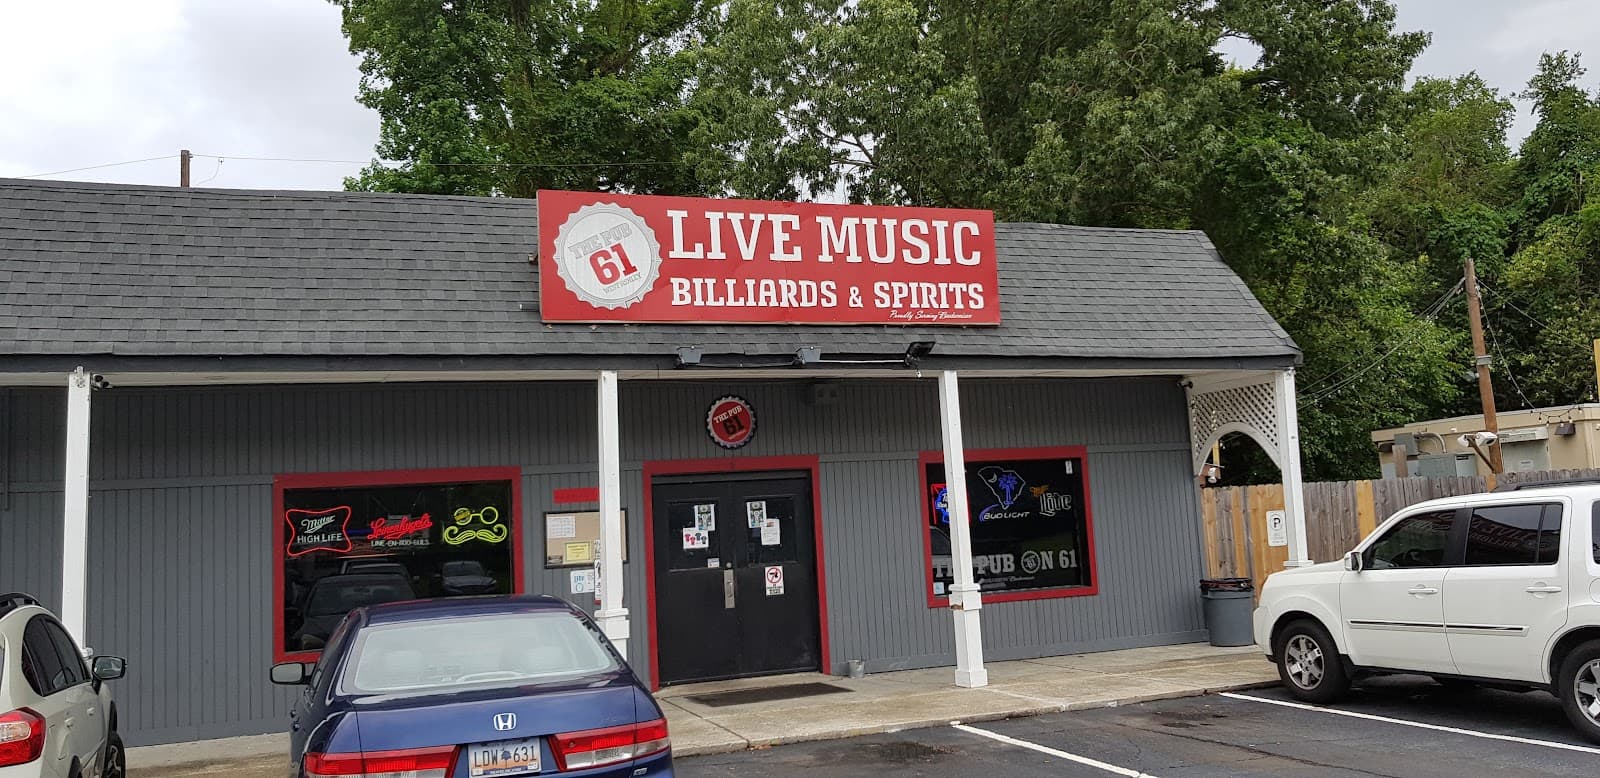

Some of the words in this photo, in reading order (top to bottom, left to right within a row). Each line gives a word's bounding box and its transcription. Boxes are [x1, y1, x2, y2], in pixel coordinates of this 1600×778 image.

[568, 235, 603, 260] THE
[600, 222, 633, 247] PUB
[667, 210, 802, 261] LIVE
[816, 215, 981, 265] MUSIC
[589, 243, 638, 286] 61
[670, 277, 837, 308] BILLIARDS
[848, 286, 864, 308] &
[873, 281, 984, 309] SPIRITS
[889, 310, 913, 320] Proudly
[713, 412, 728, 423] THE
[728, 405, 742, 416] PUB
[723, 416, 745, 435] 61
[301, 515, 336, 533] Miller
[983, 511, 1003, 520] BUD
[1003, 511, 1030, 519] LIGHT
[297, 534, 320, 543] HIGH
[321, 532, 343, 542] LIFE
[975, 553, 1015, 575] PUB
[1058, 549, 1078, 569] 61
[474, 749, 498, 768] LDW
[513, 745, 537, 763] 631
